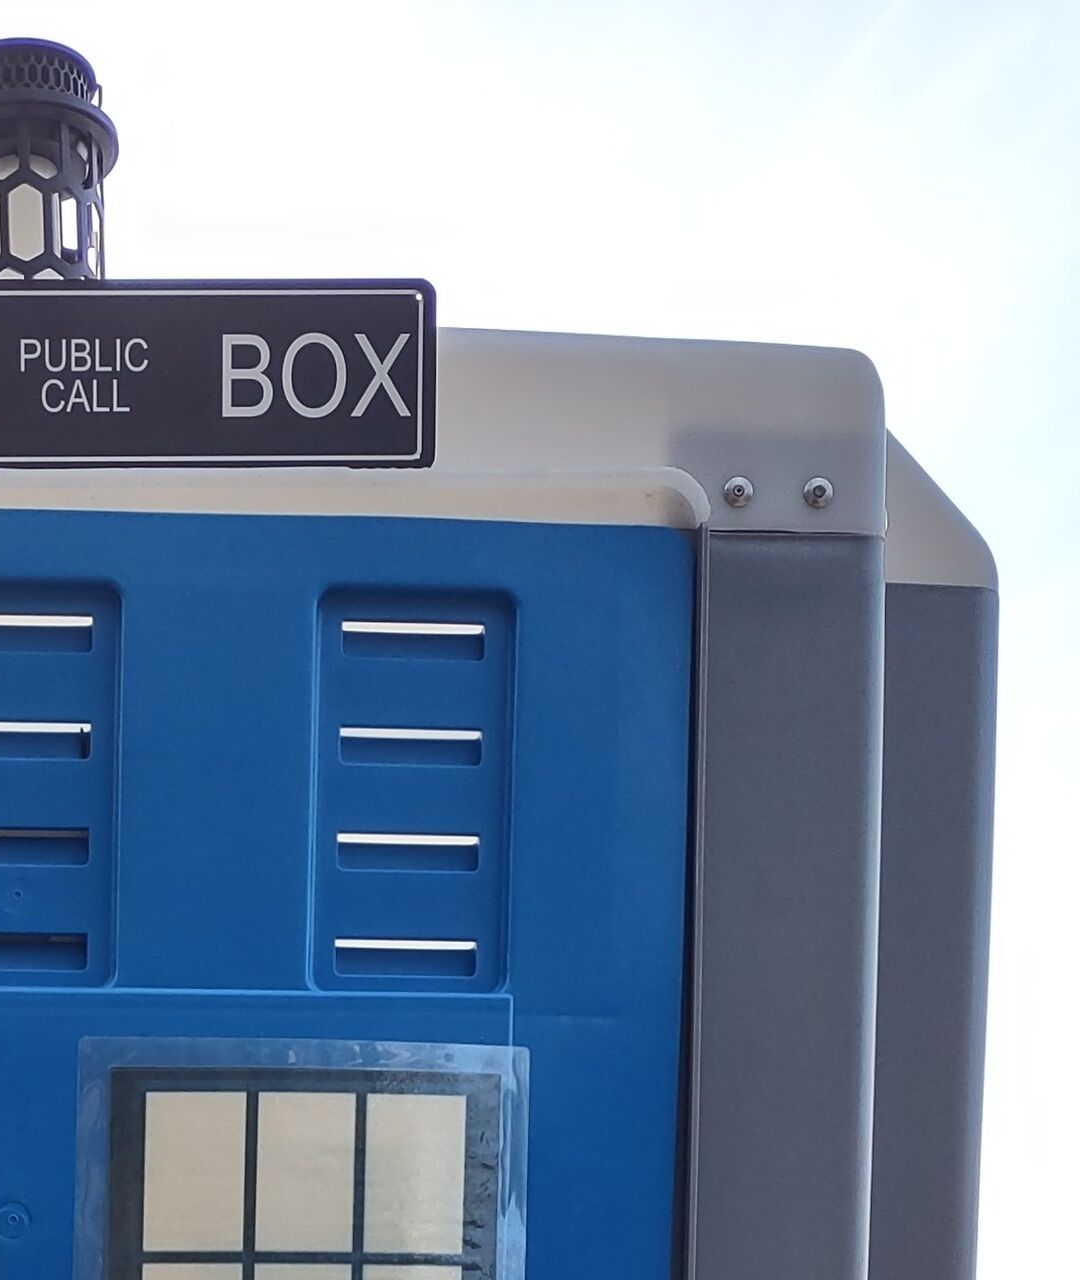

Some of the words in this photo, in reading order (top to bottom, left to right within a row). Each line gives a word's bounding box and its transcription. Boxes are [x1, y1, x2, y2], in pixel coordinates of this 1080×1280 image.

[19, 338, 150, 374] PUBLIC
[220, 333, 412, 420] BOX
[40, 379, 131, 414] CALL
